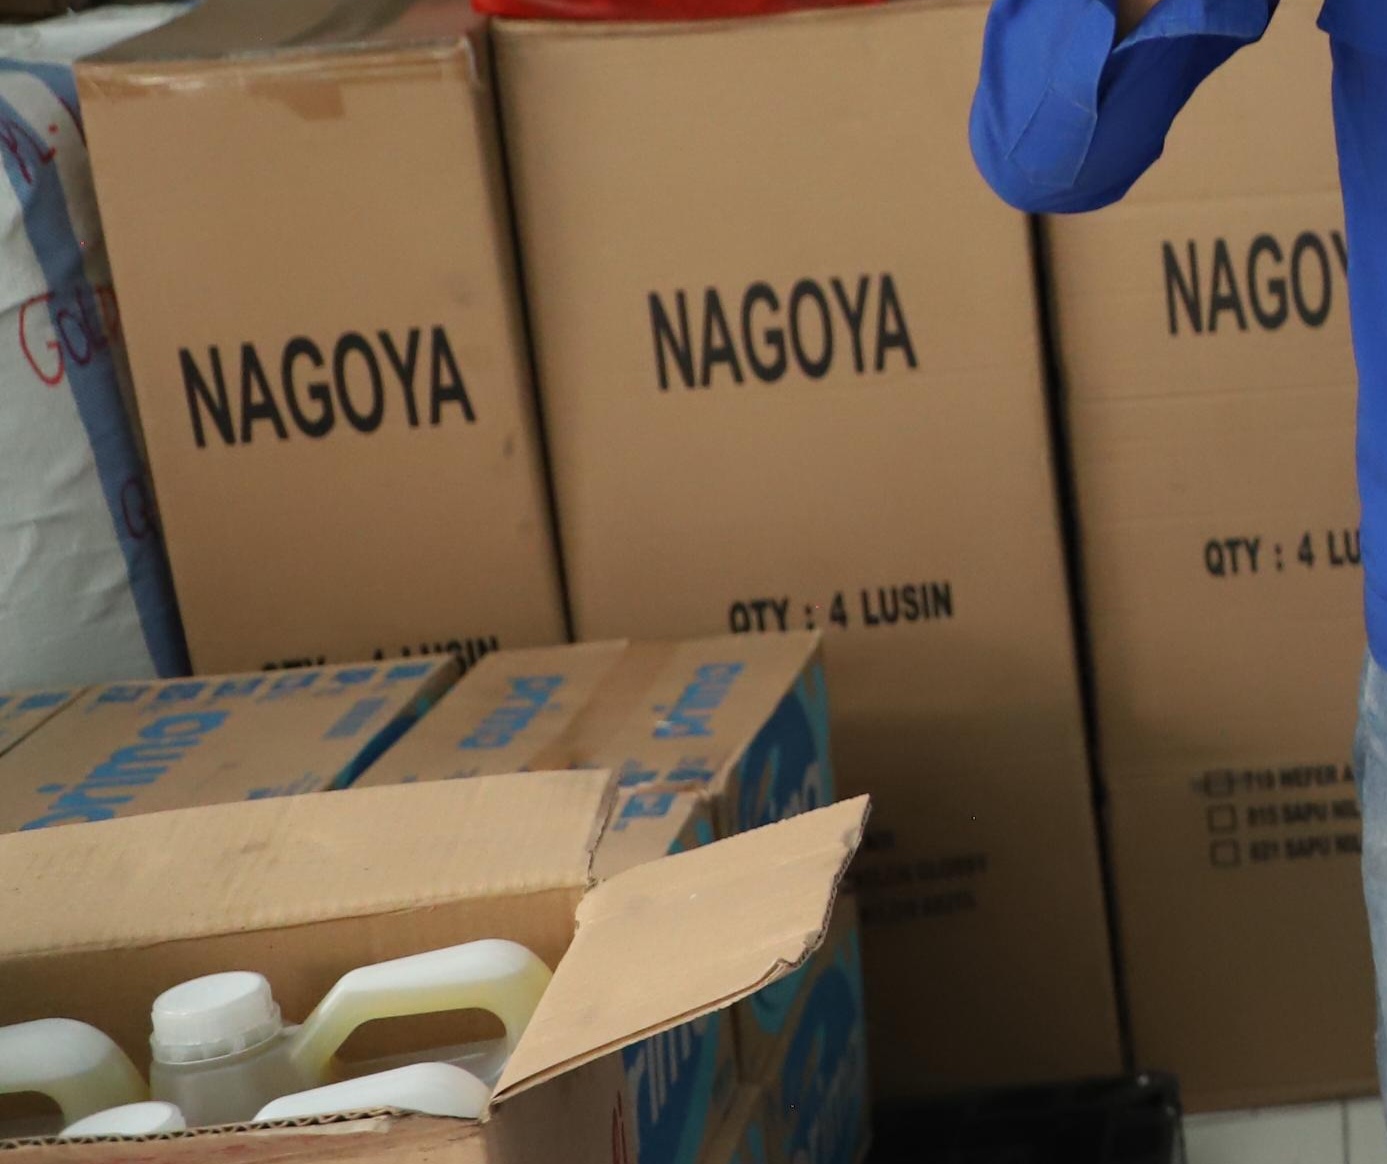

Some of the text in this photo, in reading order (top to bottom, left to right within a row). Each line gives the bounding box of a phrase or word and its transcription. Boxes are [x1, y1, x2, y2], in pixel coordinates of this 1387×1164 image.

[649, 272, 918, 391] NAGOYA
[179, 324, 477, 448] NAGOYA
[1205, 538, 1260, 576] QTY
[1298, 531, 1315, 567] 4
[830, 591, 847, 626] 4
[862, 581, 954, 626] LUSIN
